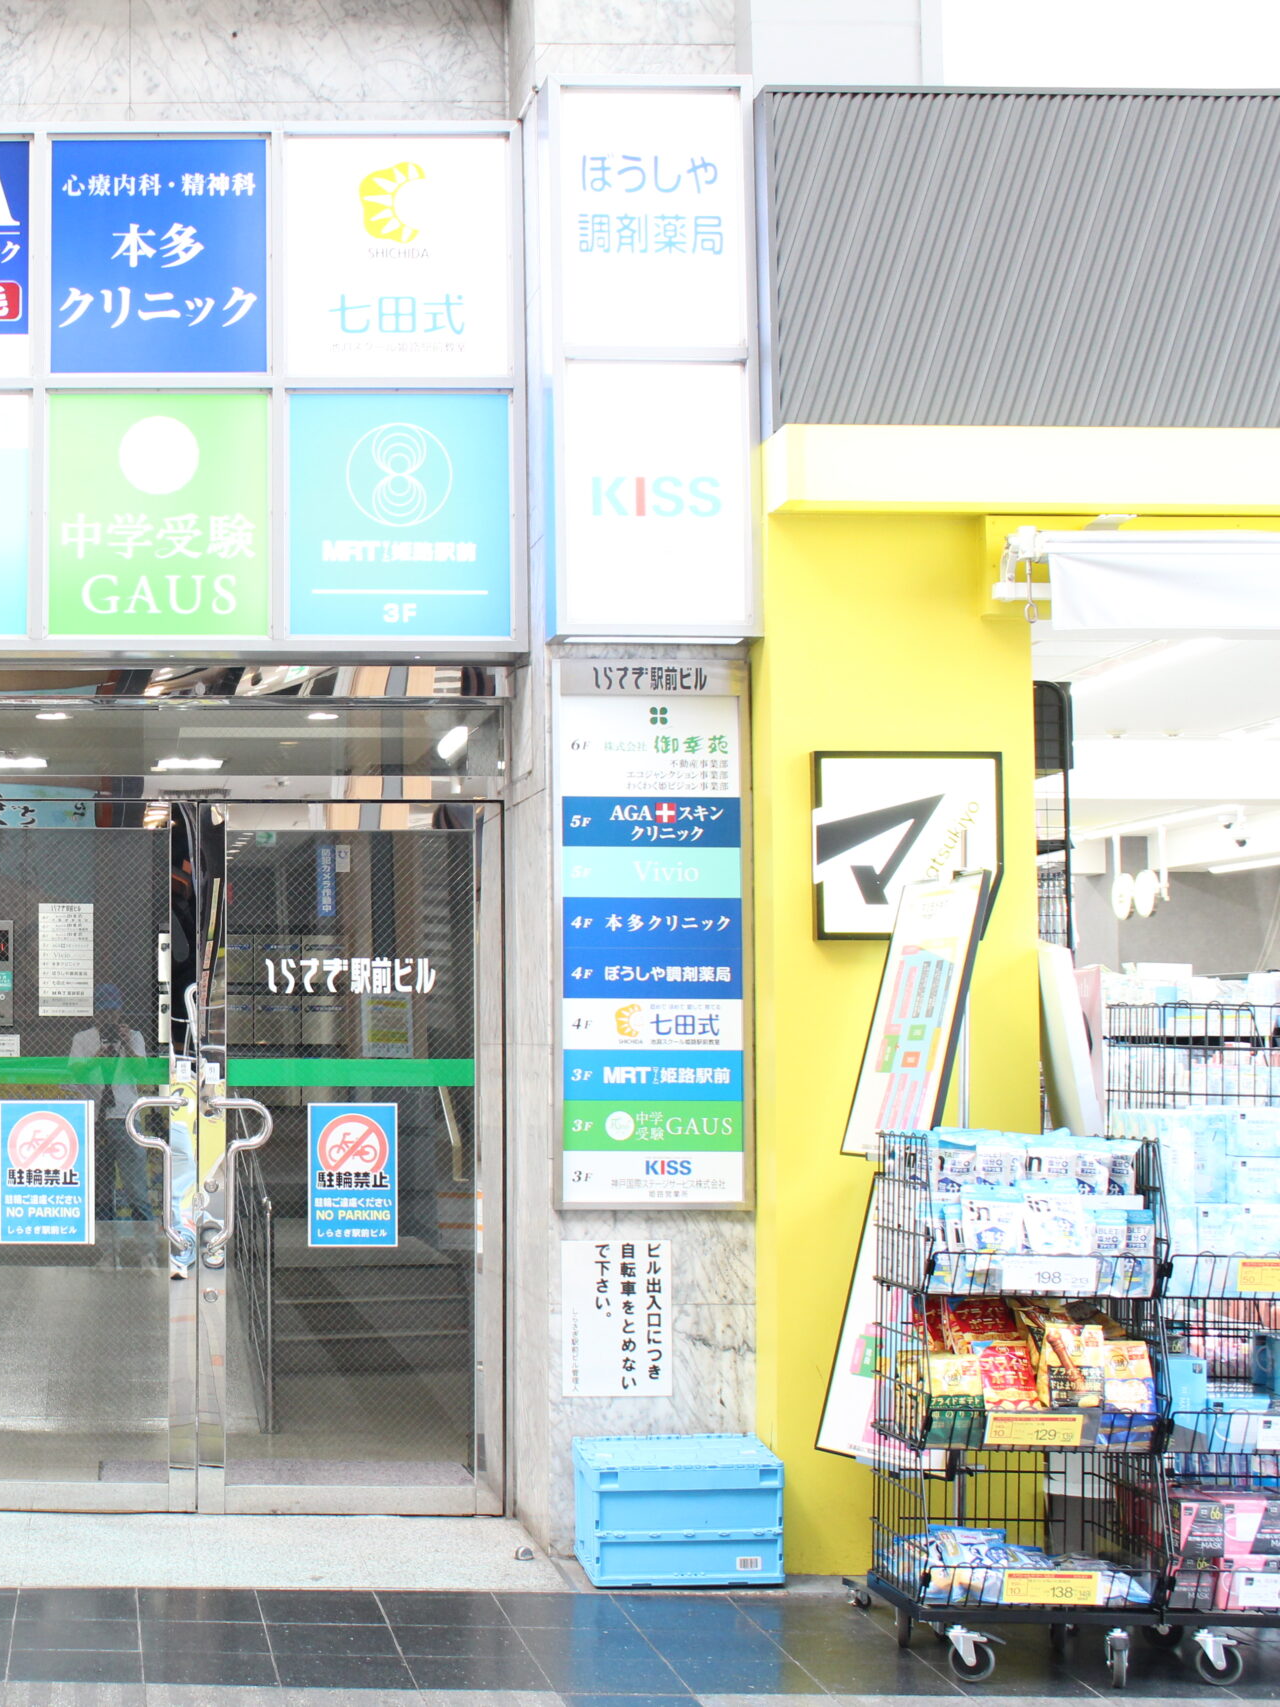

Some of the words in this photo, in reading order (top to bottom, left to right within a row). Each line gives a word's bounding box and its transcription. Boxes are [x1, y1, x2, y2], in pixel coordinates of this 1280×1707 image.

[581, 154, 718, 194] ぼうしや
[62, 172, 256, 197] 心療内科・精神科
[578, 213, 724, 256] 調剤薬局
[111, 222, 205, 269] 本多
[368, 247, 430, 260] SHICHIDA
[58, 286, 258, 329] クリニック
[328, 293, 465, 336] 七田式
[591, 476, 723, 517] KISS
[61, 512, 257, 560] 中学受験
[81, 573, 238, 615] GAUS
[383, 603, 417, 623] 3F
[571, 739, 591, 751] 6F
[604, 741, 648, 752] 株式会社
[654, 735, 729, 754] 御幸苑
[570, 815, 592, 828] 5F
[609, 805, 653, 821] AGA
[678, 805, 724, 821] スキン
[631, 826, 704, 842] クリニック
[926, 800, 980, 880] atsukiyo
[571, 866, 592, 879] 5F
[633, 860, 700, 882] Vivio
[571, 916, 593, 929] 4F
[605, 913, 731, 932] 本多クリニック
[571, 967, 593, 980] 4F
[604, 965, 732, 982] ぼうしや調剤薬局
[572, 1018, 592, 1029] 4F
[650, 1013, 720, 1036] 七田式
[571, 1069, 593, 1081] 3F
[603, 1066, 651, 1084] MRT
[660, 1066, 731, 1084] 姫路駅前
[572, 1120, 593, 1132] 3F
[636, 1111, 664, 1125] 中学
[666, 1117, 733, 1135] GAUS
[635, 1126, 665, 1141] 受験
[7, 1168, 80, 1186] 駐輪禁止
[317, 1171, 390, 1189] 駐輪禁止
[572, 1171, 592, 1183] 3F
[645, 1160, 692, 1175] KISS
[6, 1207, 24, 1218] NO
[28, 1207, 81, 1218] PARKING
[316, 1210, 334, 1221] NO
[338, 1210, 391, 1221] PARKING
[7, 1226, 78, 1235] しらさぎ駅前ビル
[317, 1229, 388, 1238] しらさぎ駅前ビル
[594, 1243, 612, 1317] で下さい。
[1035, 1271, 1062, 1284] 198
[1242, 1275, 1255, 1283] 50
[619, 1243, 637, 1390] 自転車をとめない
[646, 1243, 663, 1380] ビル出入口につき
[1034, 1429, 1057, 1441] 129
[1201, 1541, 1223, 1549] MASK
[1050, 1586, 1073, 1599] 138
